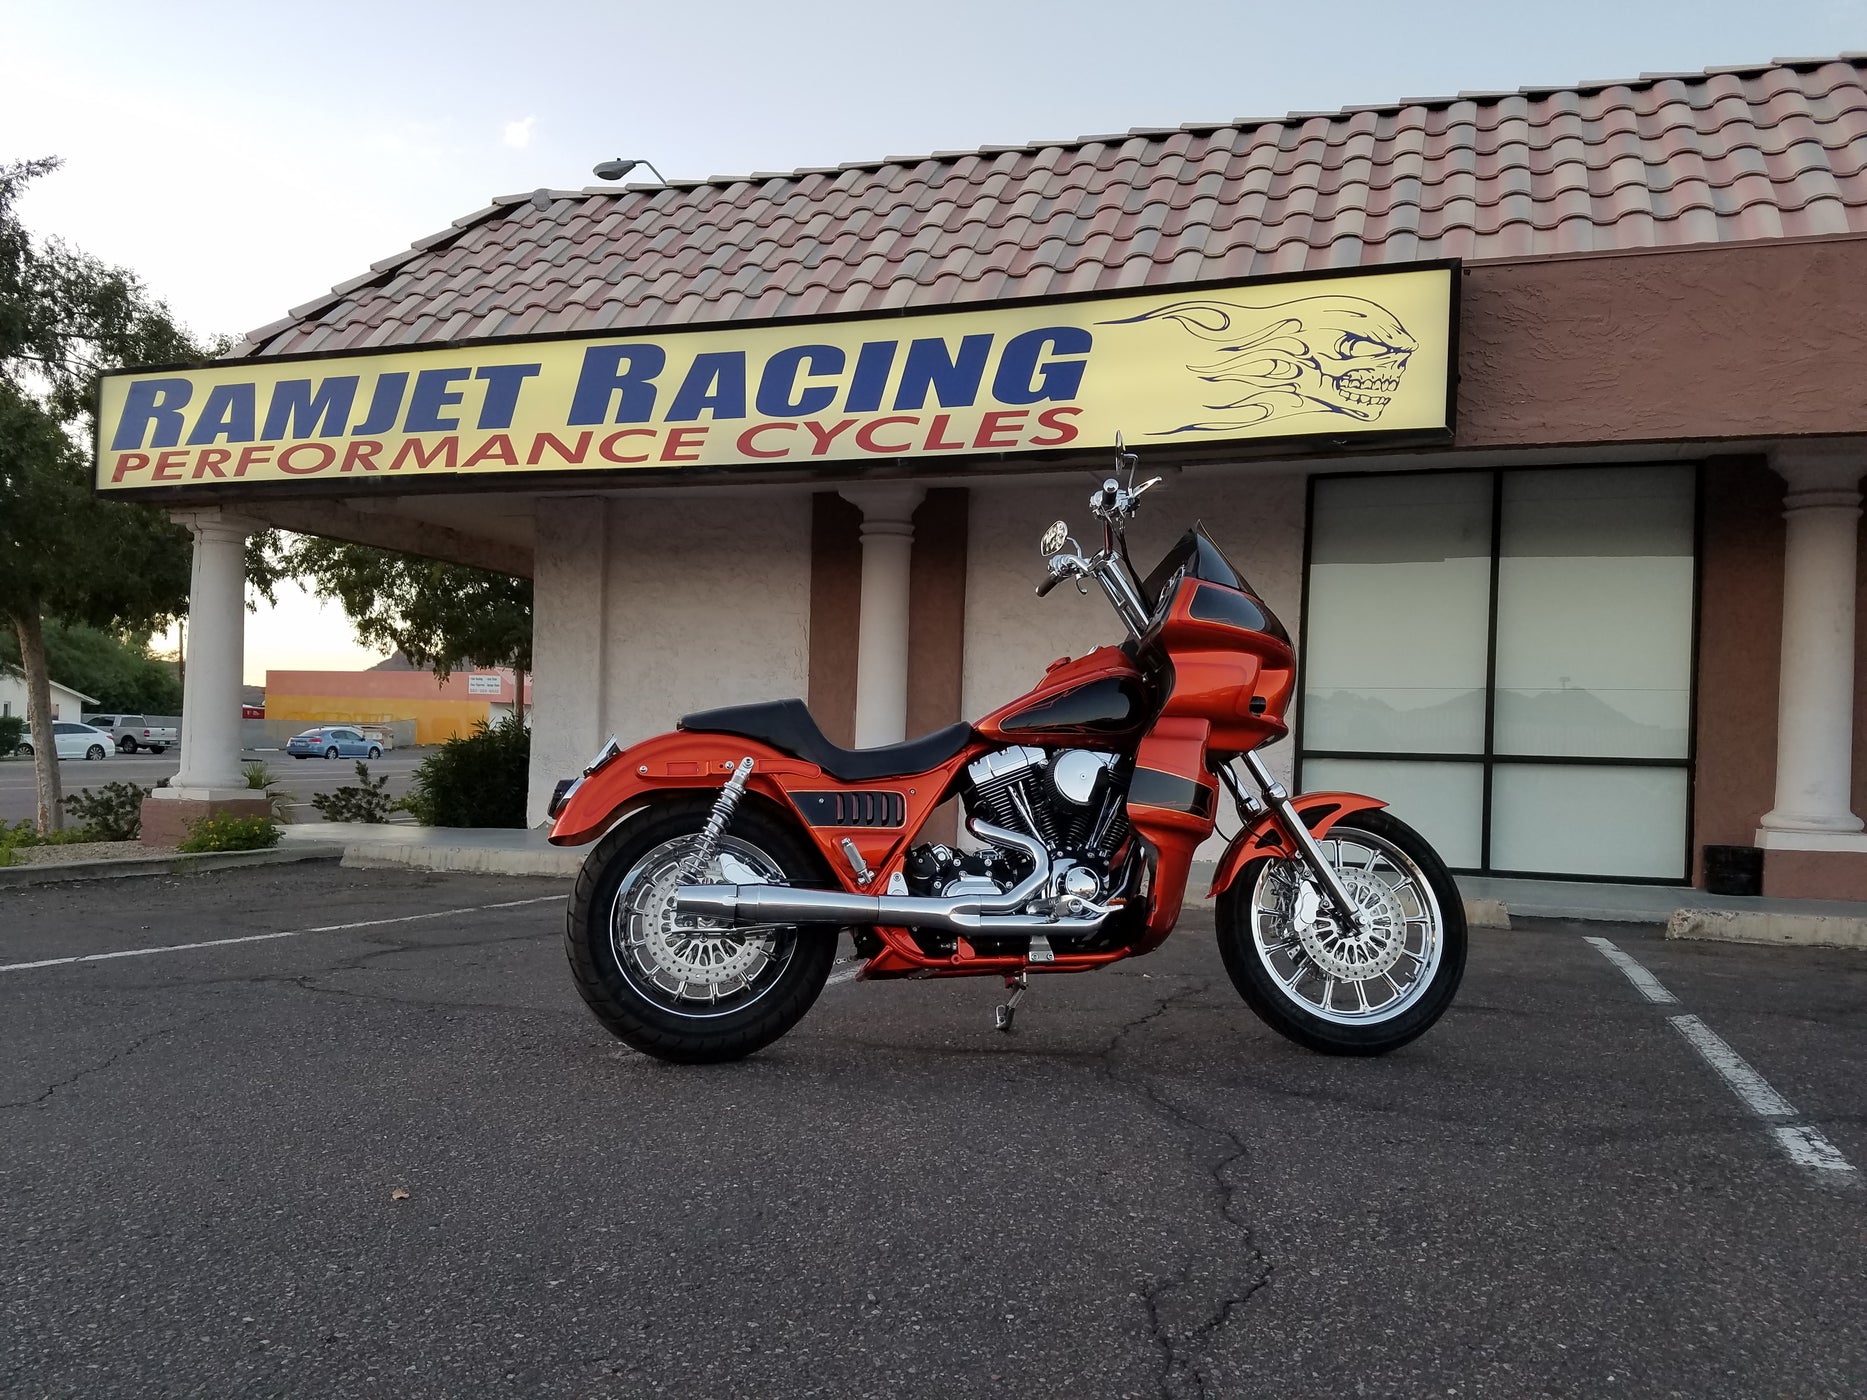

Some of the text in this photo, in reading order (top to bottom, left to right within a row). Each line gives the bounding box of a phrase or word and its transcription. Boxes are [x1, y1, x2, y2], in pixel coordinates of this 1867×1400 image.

[112, 326, 1093, 451] RAMJET RACING
[111, 407, 1084, 483] PERFORMANCE CYCLES
